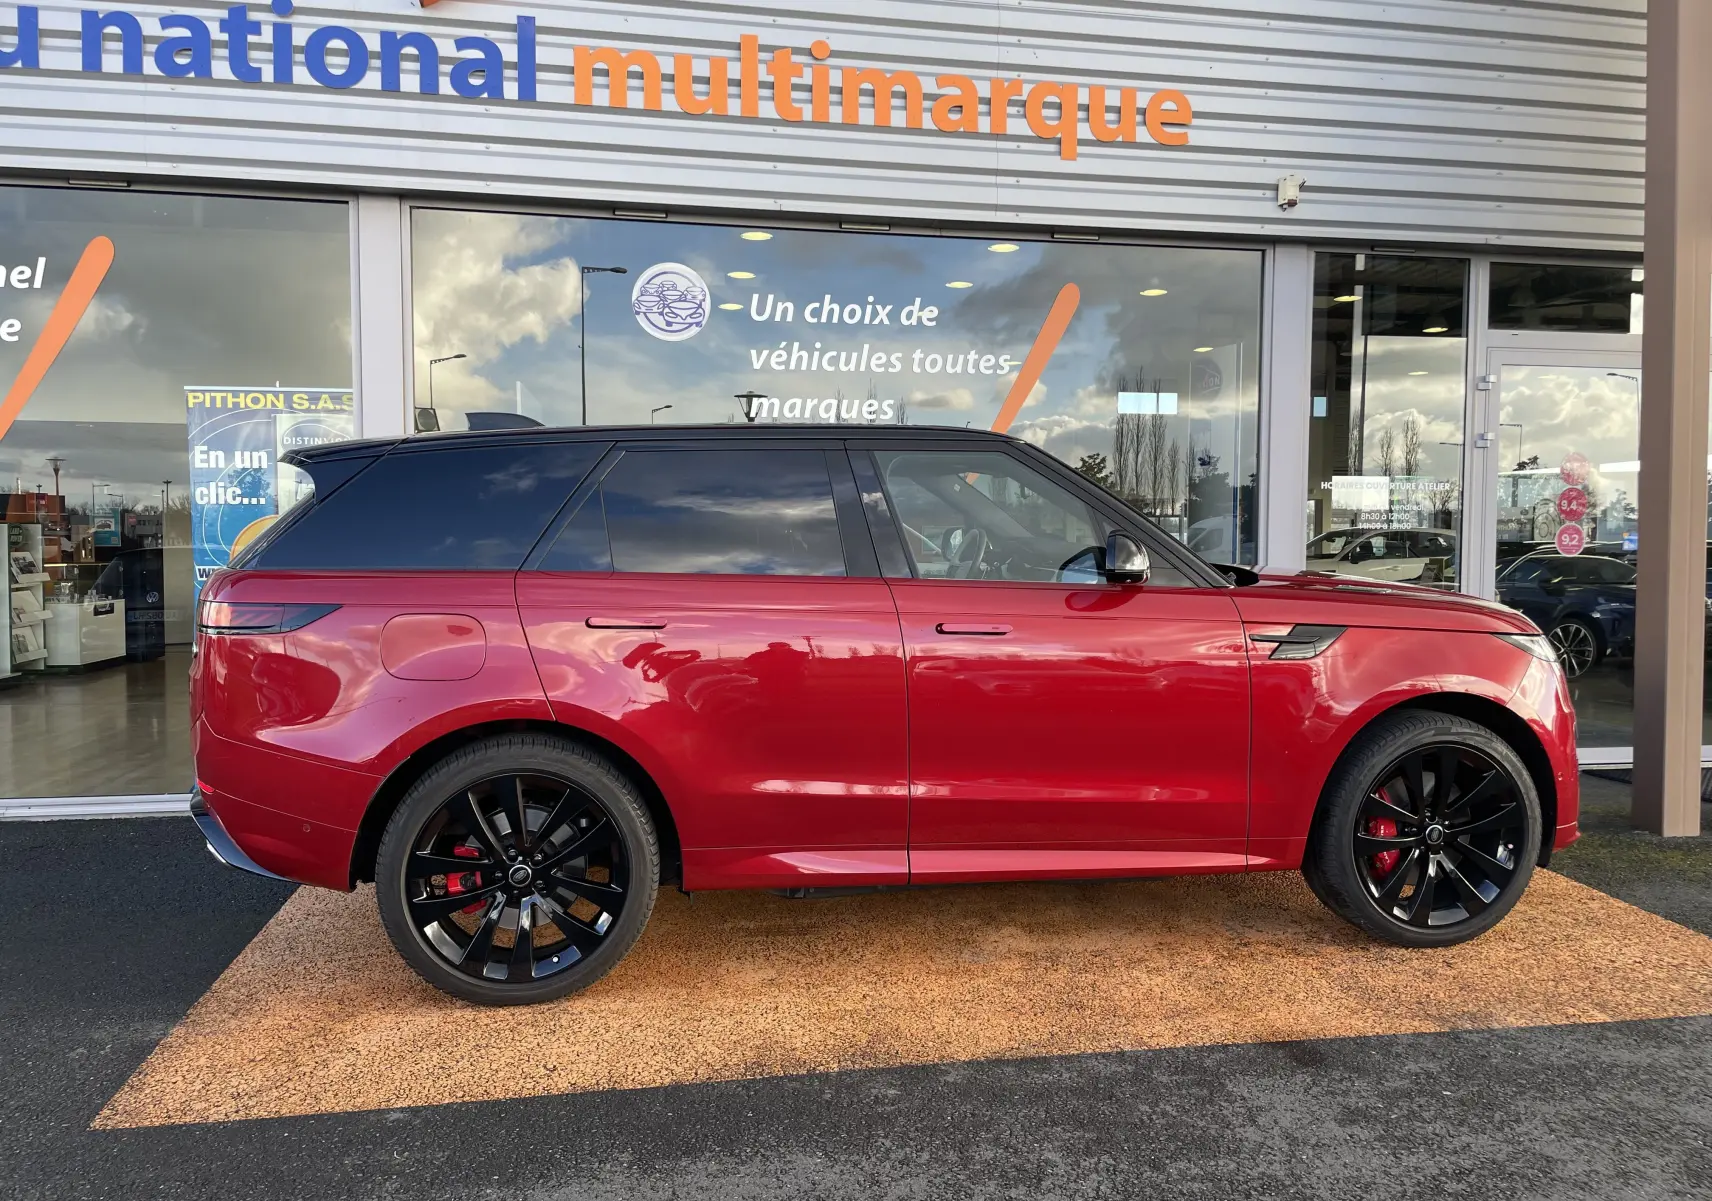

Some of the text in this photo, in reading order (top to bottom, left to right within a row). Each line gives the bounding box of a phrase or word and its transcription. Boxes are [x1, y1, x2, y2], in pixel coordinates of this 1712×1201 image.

[81, 0, 536, 102] national
[573, 34, 1192, 161] multimarque
[750, 293, 939, 326] Un choix de
[749, 341, 1011, 375] véhicules toutes
[187, 392, 285, 410] PITHON
[749, 396, 894, 424] marques
[194, 445, 268, 469] En un
[195, 481, 266, 505] clic...
[1321, 481, 1451, 490] HORAIRES OUVERTURE ATELIER
[1360, 512, 1380, 520] 8h30
[1560, 499, 1578, 511] 9,4
[1561, 534, 1579, 547] 9,2
